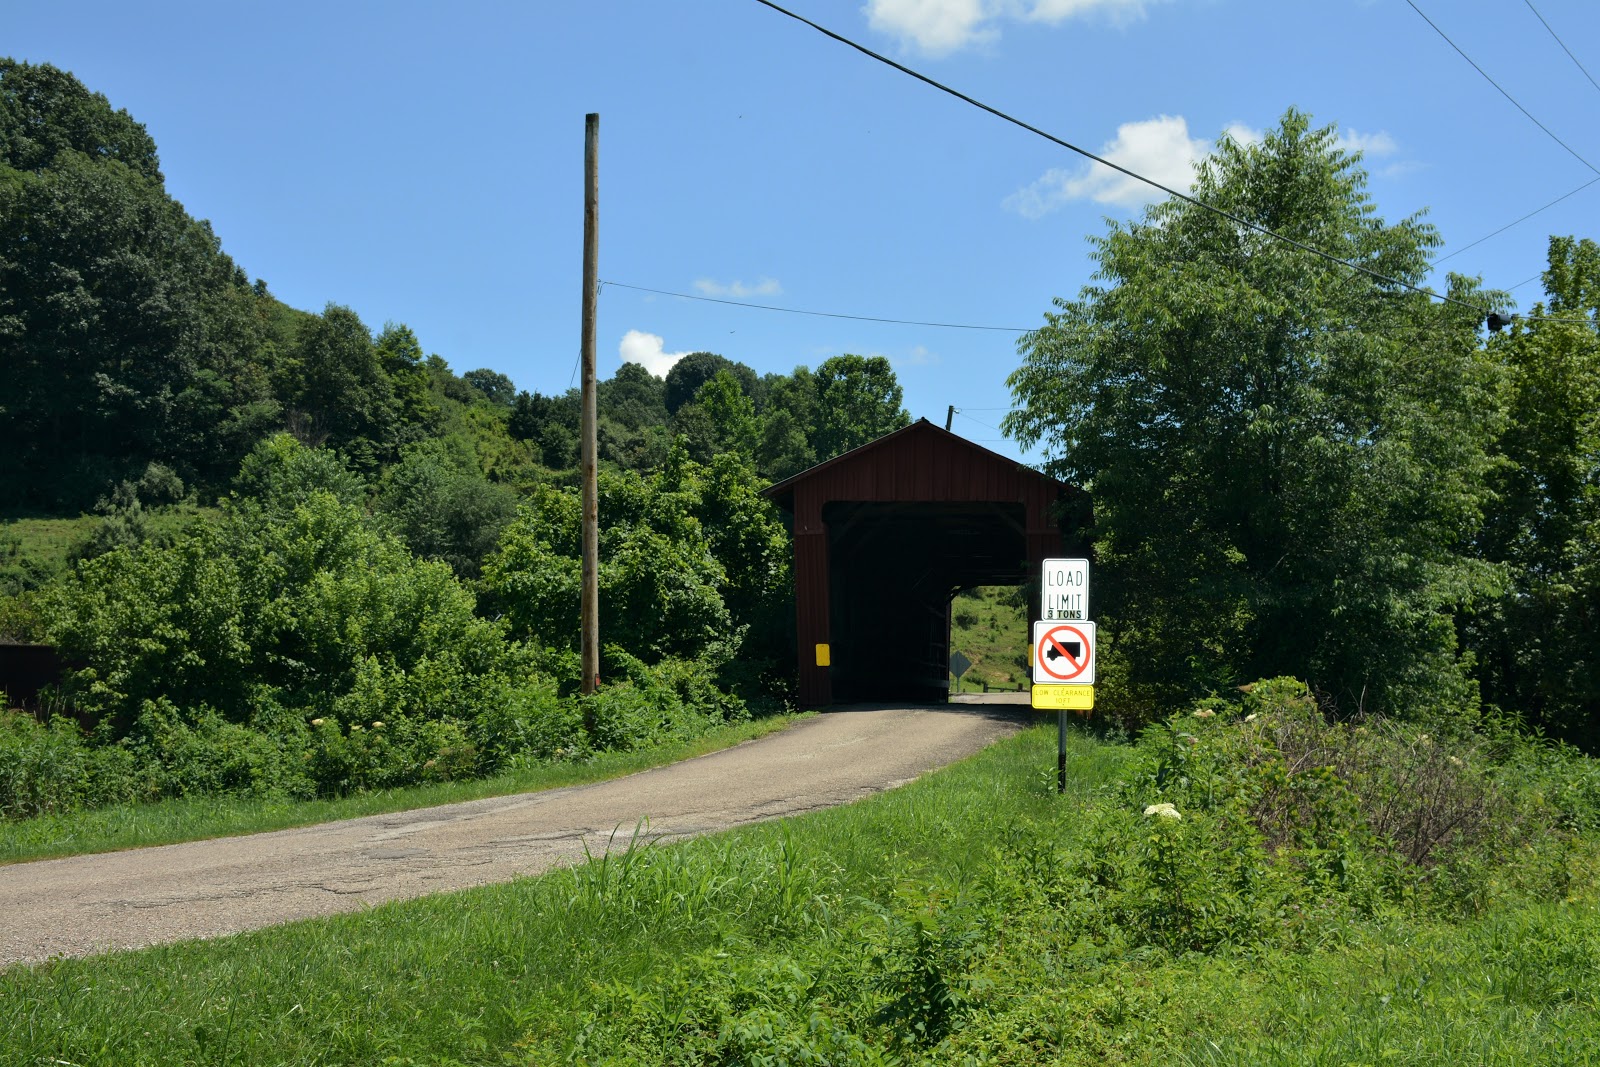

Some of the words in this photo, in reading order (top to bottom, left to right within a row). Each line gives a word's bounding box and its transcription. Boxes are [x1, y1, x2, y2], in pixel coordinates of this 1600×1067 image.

[1048, 570, 1083, 587] LOAD
[1048, 594, 1082, 610] LIMIT
[1047, 610, 1054, 619] 3
[1057, 610, 1082, 619] TONS
